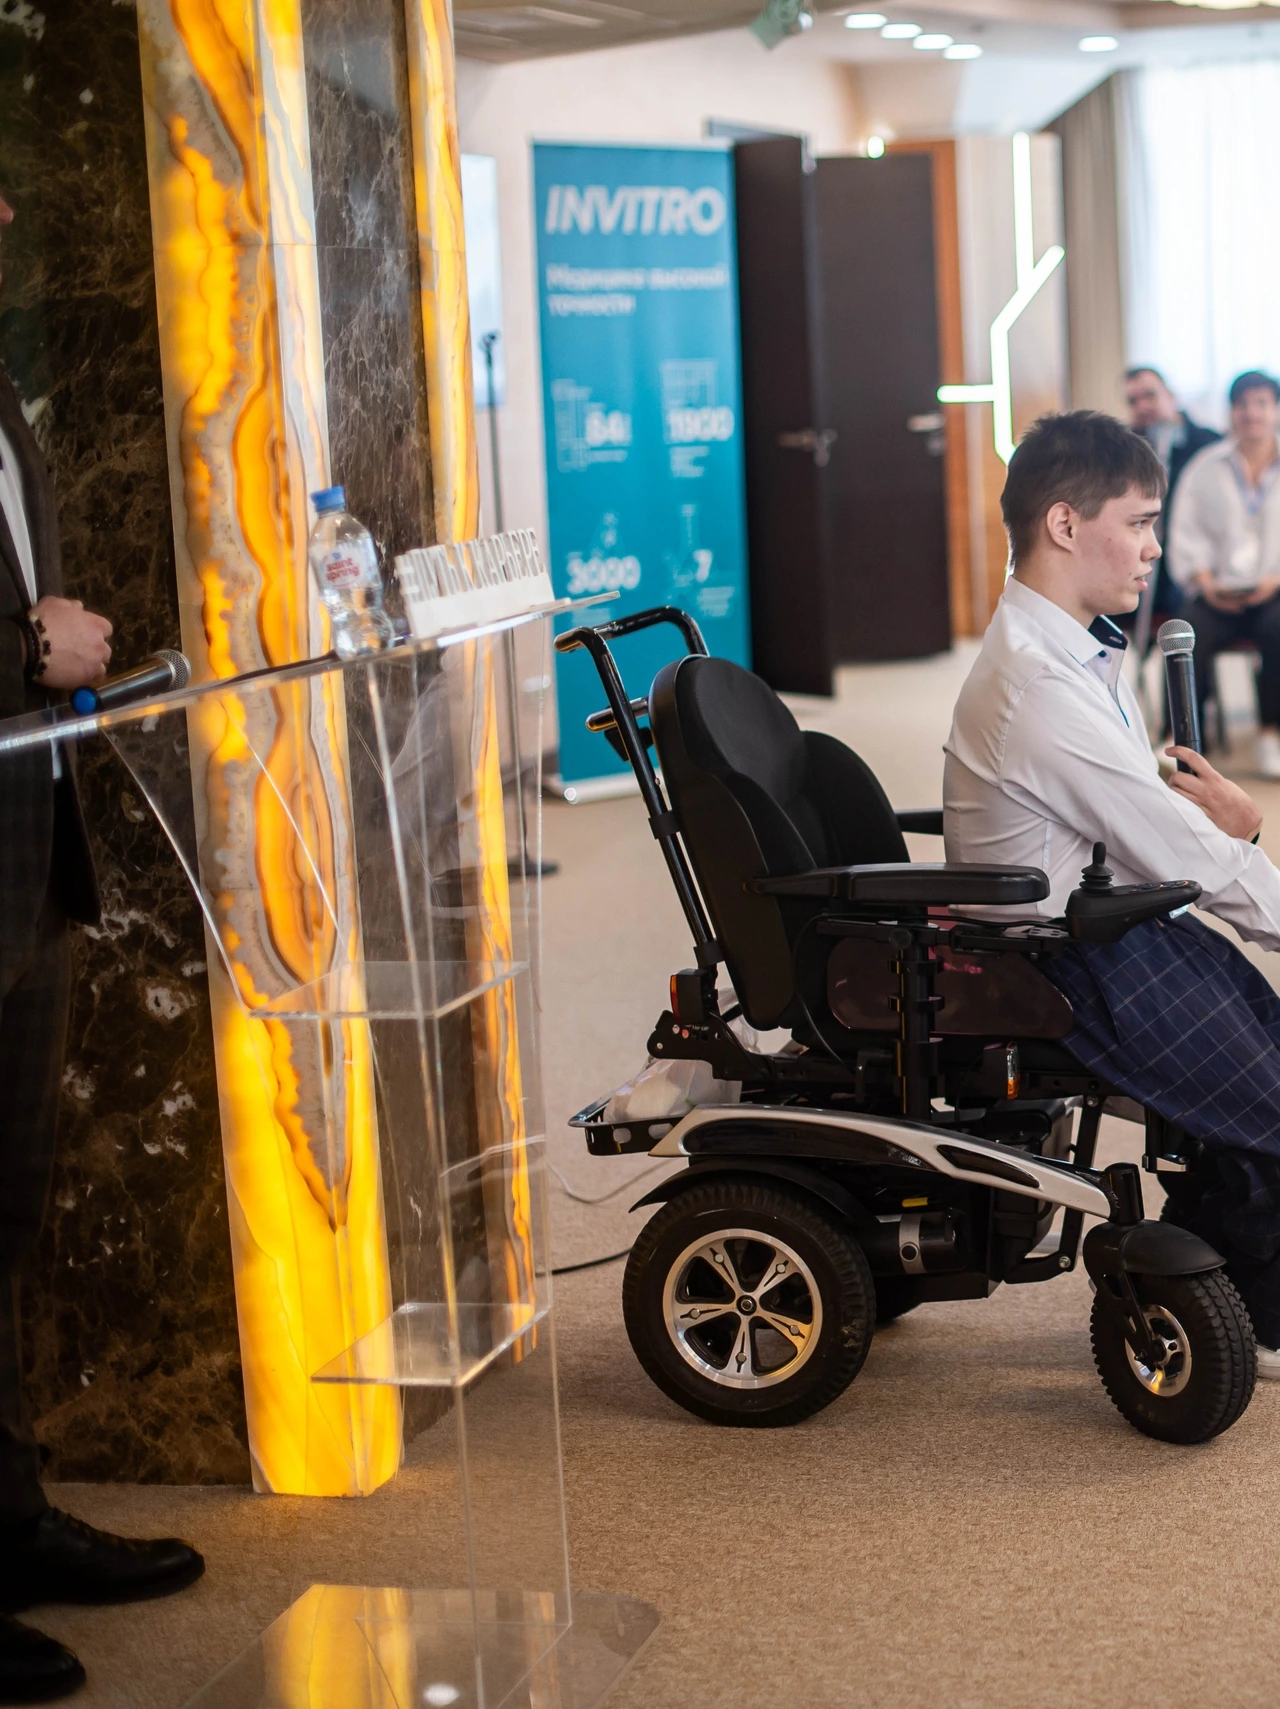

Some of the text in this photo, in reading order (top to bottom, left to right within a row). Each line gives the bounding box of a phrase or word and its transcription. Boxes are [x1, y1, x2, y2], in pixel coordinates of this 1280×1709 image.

[547, 185, 727, 235] INVITRO
[327, 558, 353, 571] saint
[326, 566, 360, 582] spring
